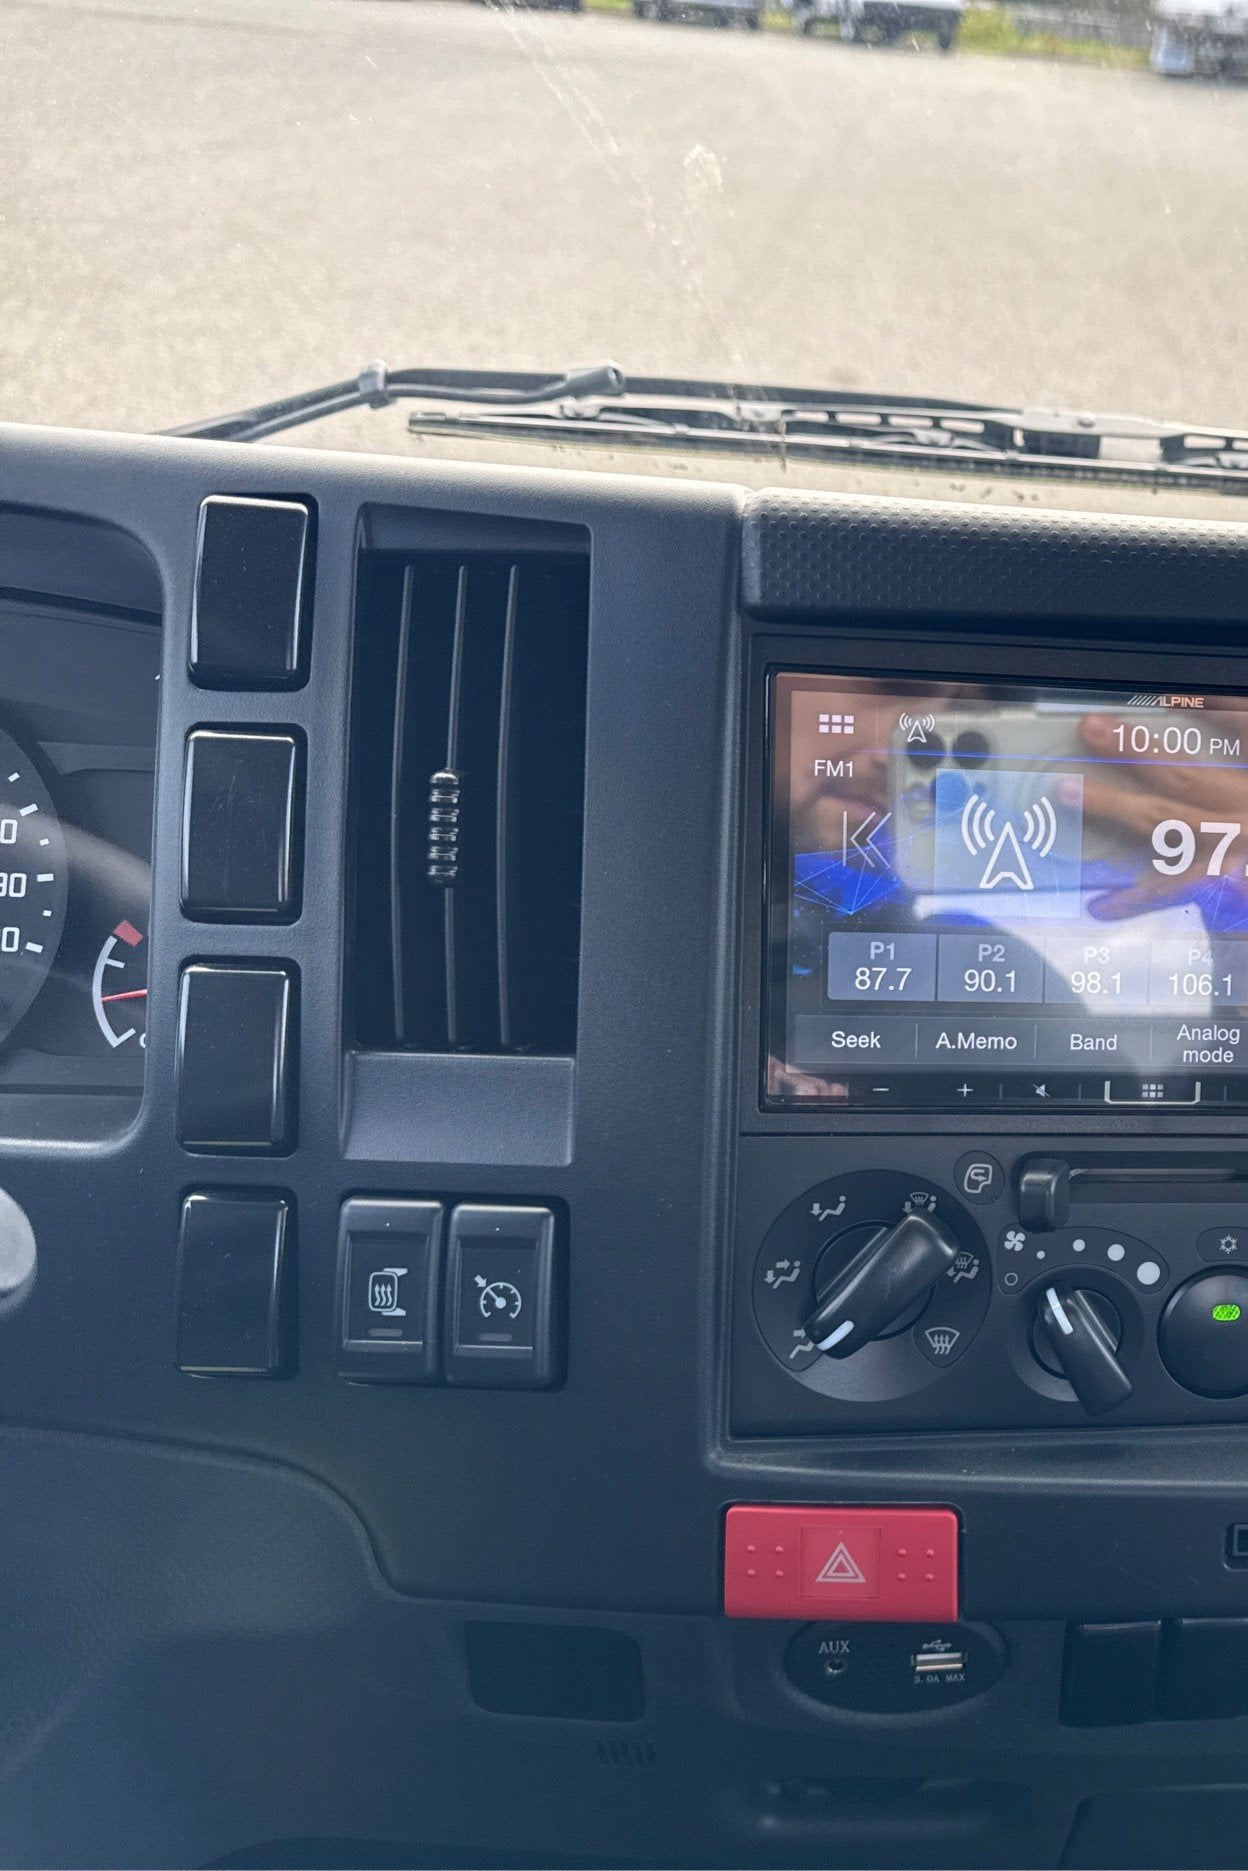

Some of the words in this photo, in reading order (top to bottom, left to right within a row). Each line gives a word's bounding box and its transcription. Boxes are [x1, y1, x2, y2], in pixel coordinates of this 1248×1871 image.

[1127, 695, 1205, 708] ALPINE
[1113, 725, 1202, 755] 10:00
[1209, 739, 1241, 756] PM
[814, 760, 854, 778] FM1
[870, 941, 896, 960] P1
[978, 944, 1006, 962] P2
[1084, 946, 1110, 964] P3
[1187, 948, 1214, 966] P4
[854, 967, 912, 991] 87.7
[964, 969, 1016, 993] 90.1
[1071, 971, 1122, 994] 98.1
[1168, 973, 1233, 996] 106.1
[831, 1030, 882, 1049] Seek
[935, 1032, 1018, 1050] A.Memo
[1070, 1034, 1118, 1051] Band
[1176, 1024, 1240, 1044] Analog
[1182, 1047, 1234, 1063] mode
[818, 1640, 850, 1654] AUX
[945, 1673, 965, 1682] MAX
